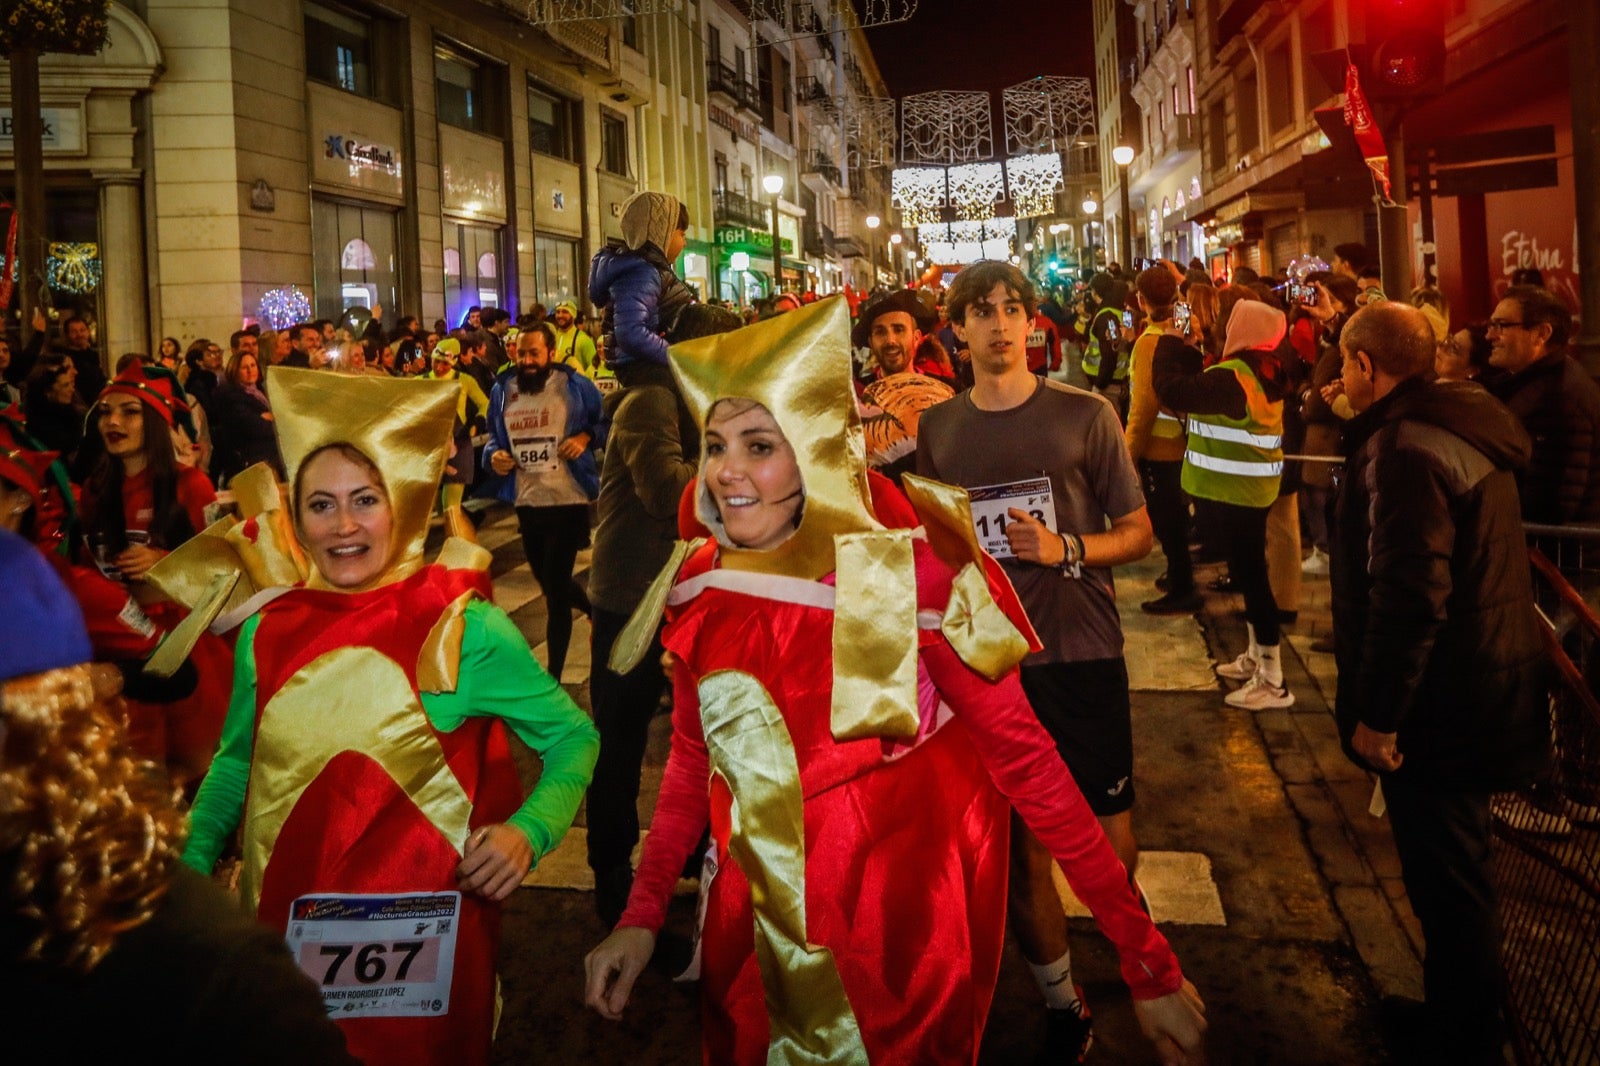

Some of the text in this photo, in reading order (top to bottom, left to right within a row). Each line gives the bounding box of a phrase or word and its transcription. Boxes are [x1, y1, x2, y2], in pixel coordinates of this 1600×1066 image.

[2, 116, 54, 136] Bk
[718, 229, 745, 244] 16H
[1501, 230, 1564, 275] Eterna
[520, 449, 550, 463] 584
[368, 908, 455, 920] #NocturnaGranada2022
[319, 941, 424, 986] 767
[321, 990, 347, 1000] ARMEN
